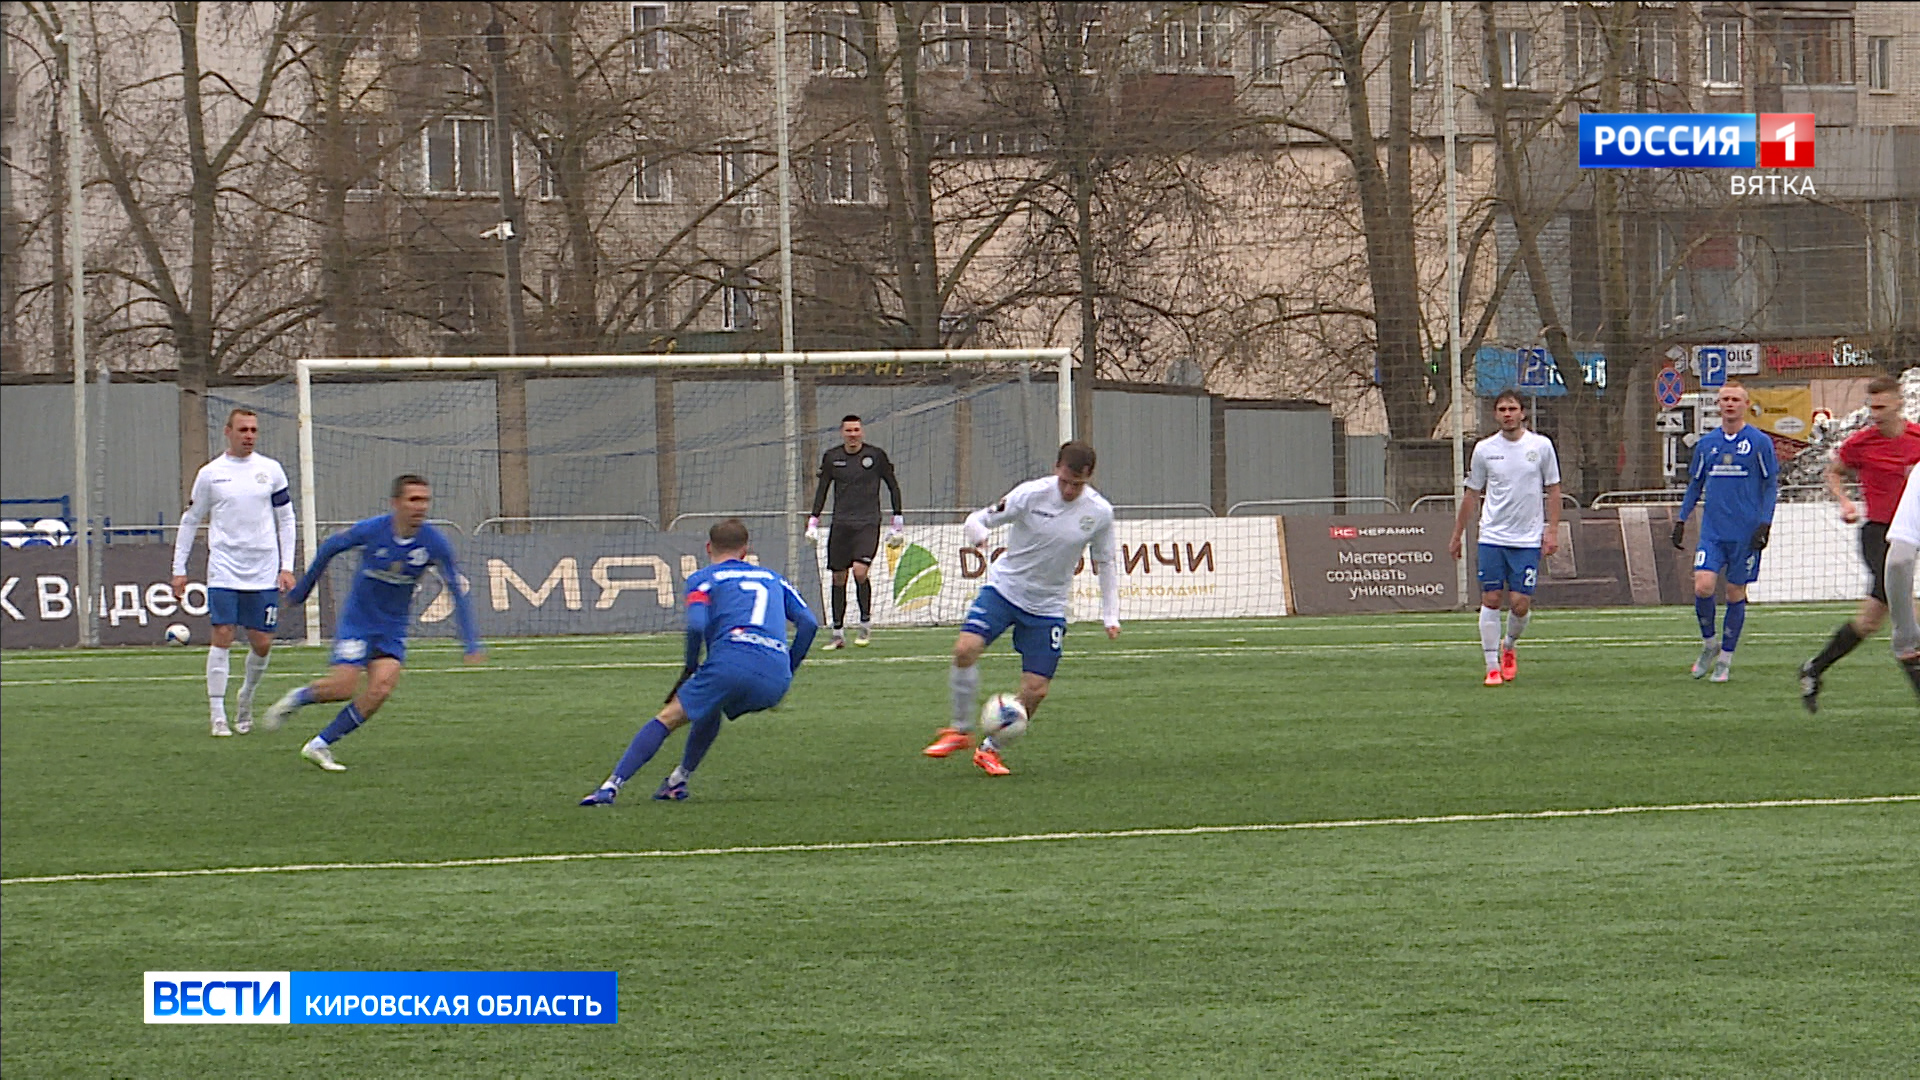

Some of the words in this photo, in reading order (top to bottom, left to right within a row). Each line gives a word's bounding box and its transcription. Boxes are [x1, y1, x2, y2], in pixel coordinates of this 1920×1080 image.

[1357, 525, 1426, 538] КЕРАМИК
[1338, 550, 1434, 568] Мастерство
[1325, 568, 1407, 583] создавать
[1350, 582, 1445, 601] уникальное
[738, 580, 769, 626] 7
[1050, 625, 1062, 650] 9
